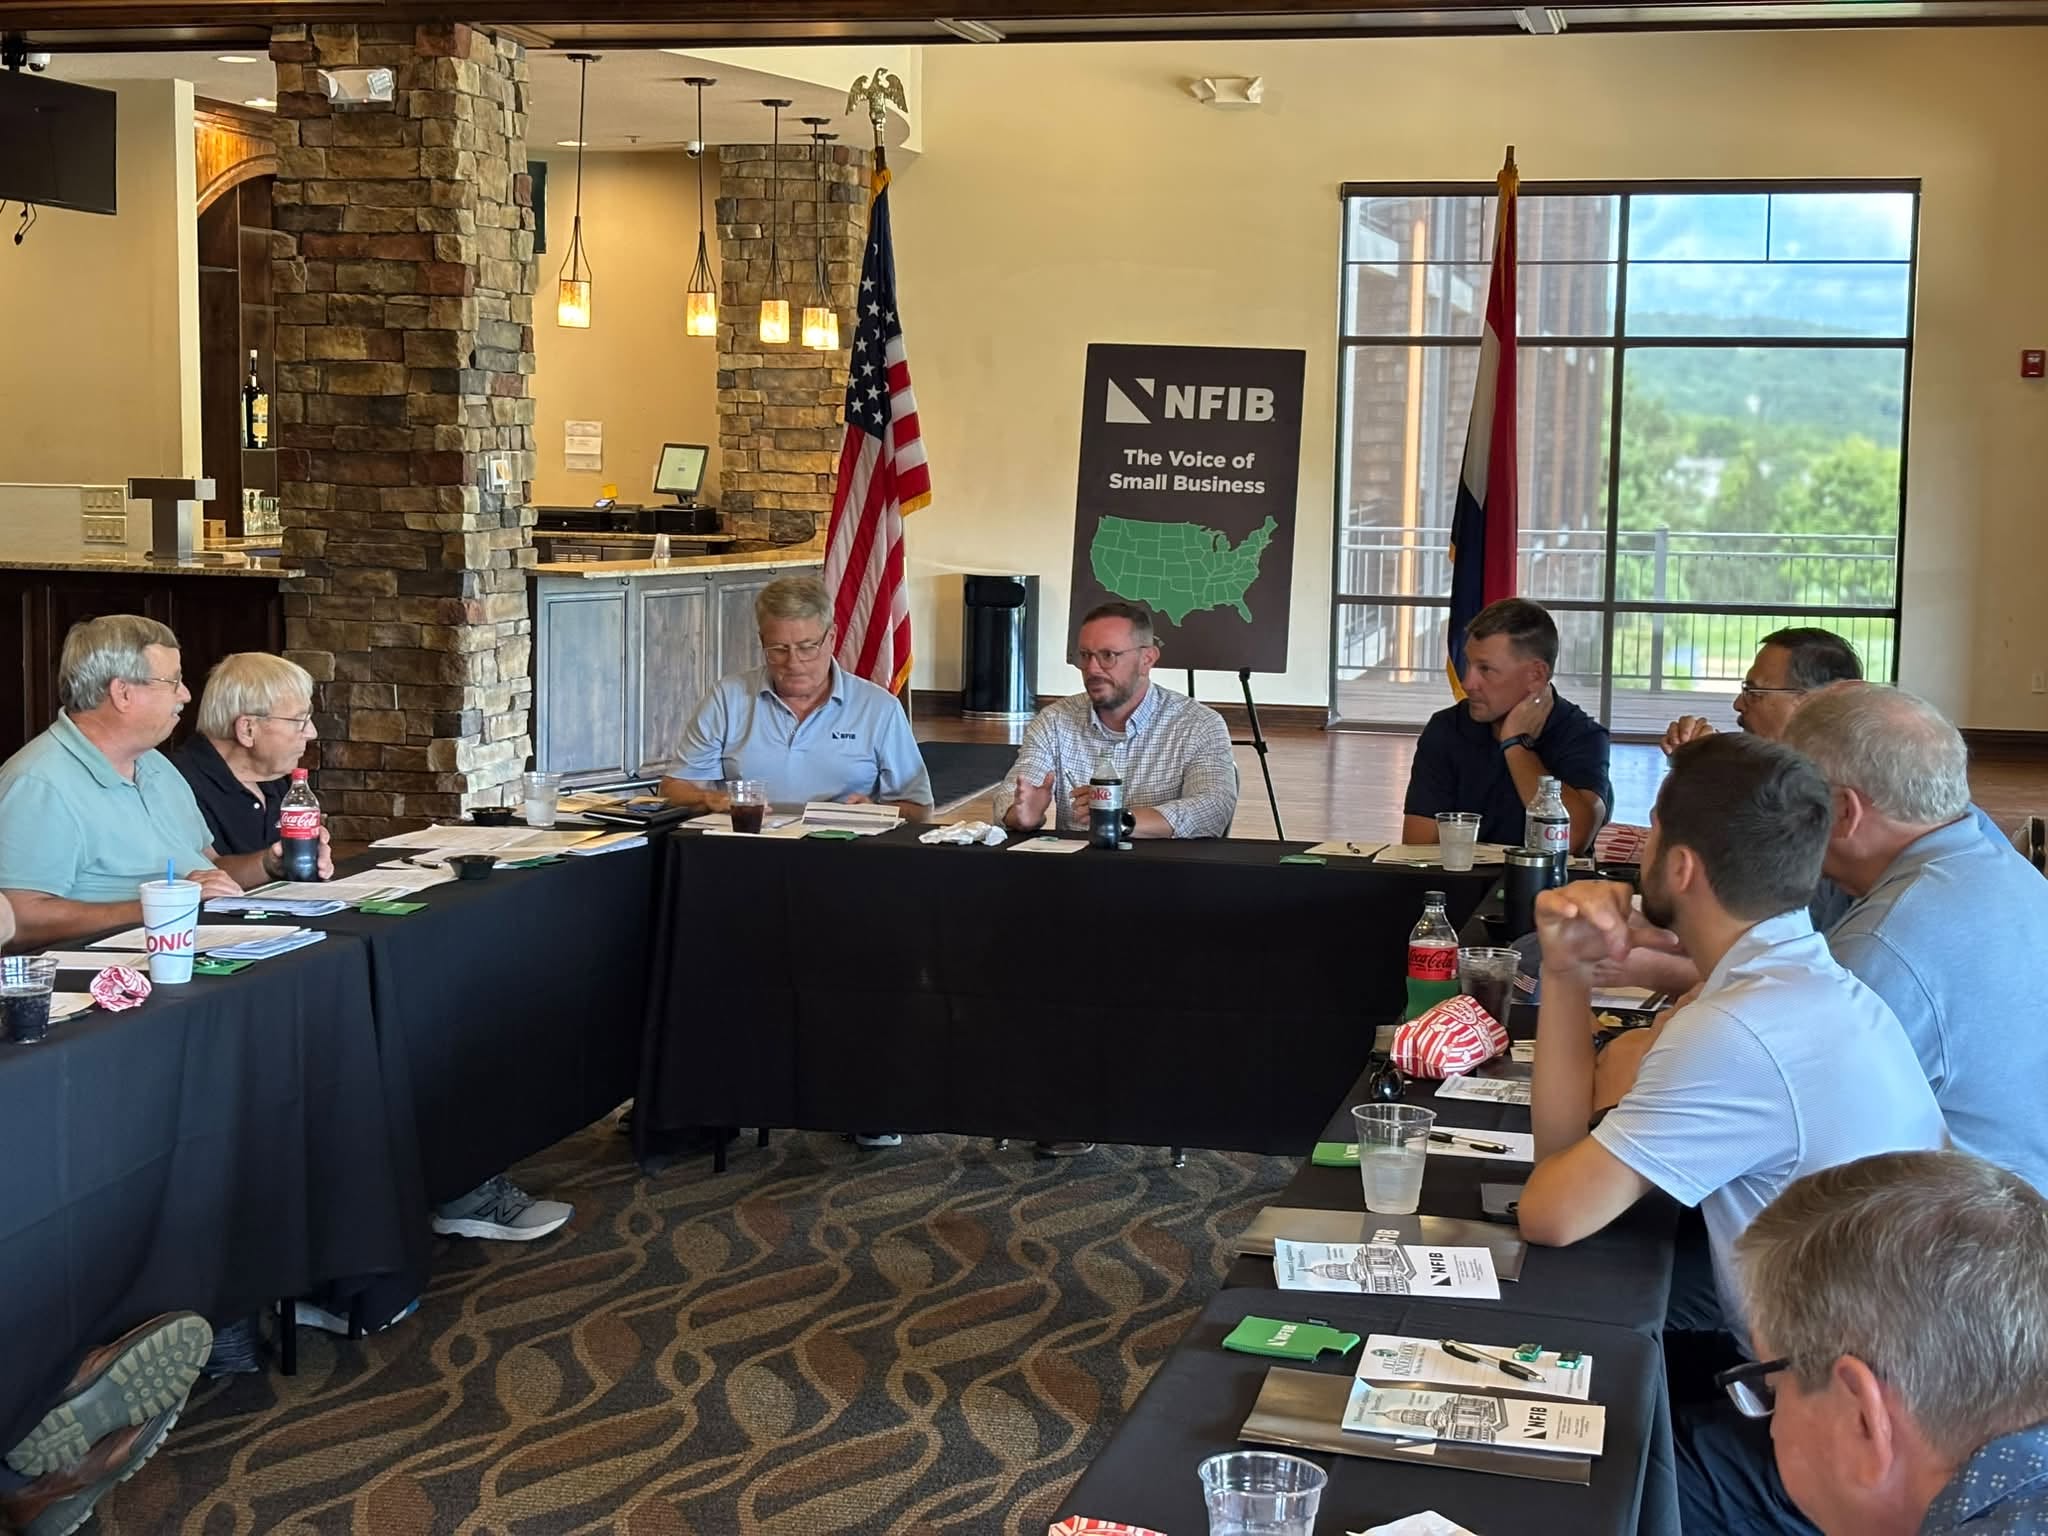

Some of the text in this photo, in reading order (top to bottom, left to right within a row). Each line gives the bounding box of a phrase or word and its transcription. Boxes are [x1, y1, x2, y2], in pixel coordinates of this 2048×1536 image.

[1164, 384, 1275, 422] NFIB
[1123, 449, 1255, 469] The Voice of
[1109, 473, 1265, 494] Small Business
[1091, 788, 1112, 800] oke
[147, 929, 193, 953] ONIC
[1428, 1252, 1448, 1274] NFIB
[1527, 1406, 1548, 1428] NFIB
